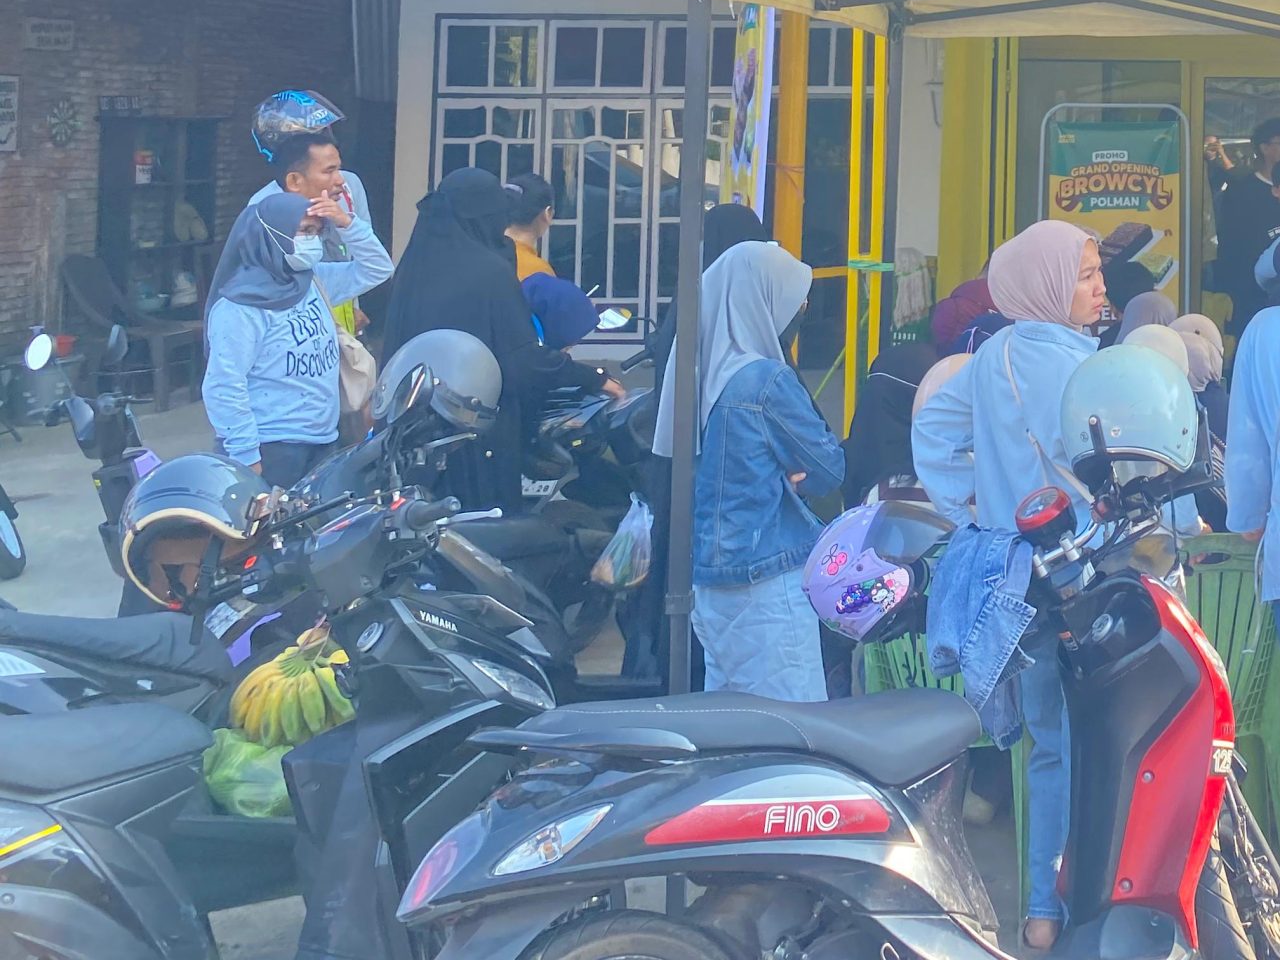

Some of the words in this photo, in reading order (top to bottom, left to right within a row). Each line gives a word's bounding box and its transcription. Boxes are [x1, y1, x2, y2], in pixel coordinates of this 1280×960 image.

[1095, 152, 1126, 160] PROMO
[1071, 163, 1110, 177] GRAND
[1111, 162, 1160, 176] OPENING
[1060, 172, 1170, 199] BROWCYL
[1090, 196, 1140, 207] POLMAN
[419, 610, 458, 632] YAMAHA
[763, 803, 841, 834] FINO
